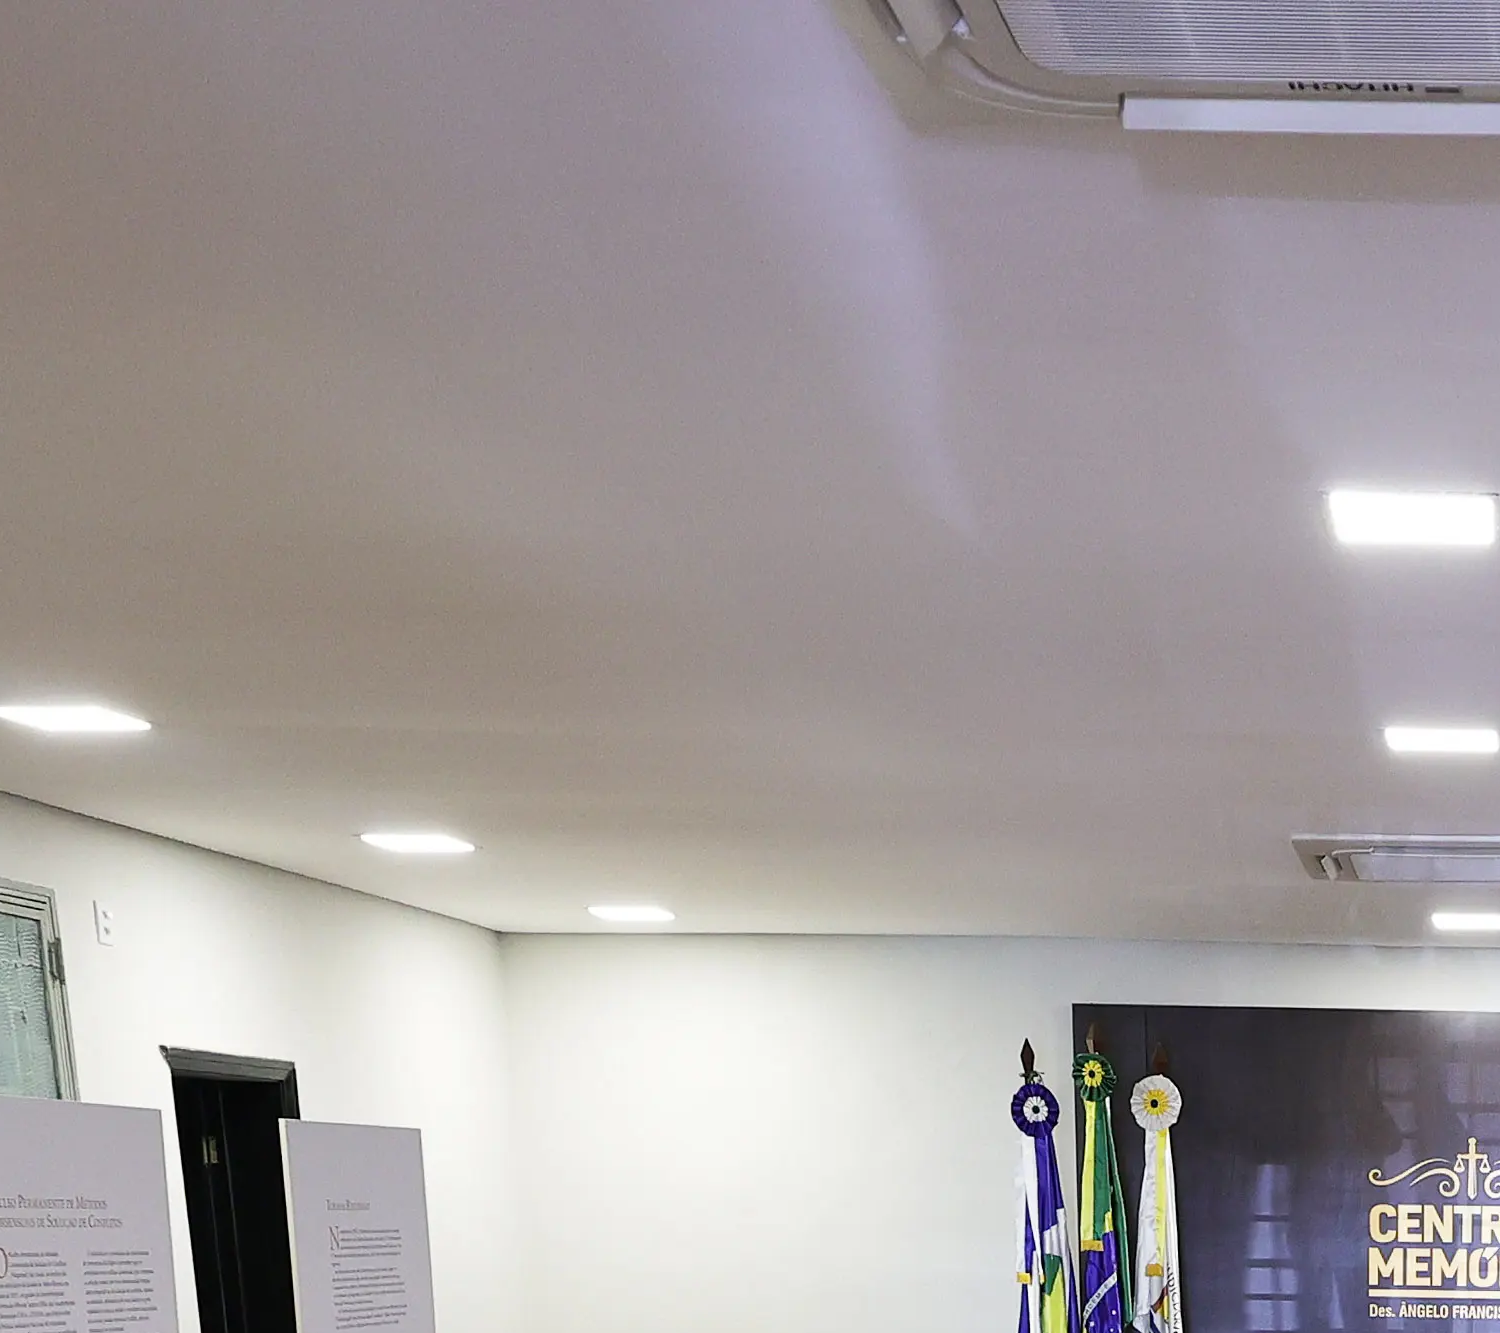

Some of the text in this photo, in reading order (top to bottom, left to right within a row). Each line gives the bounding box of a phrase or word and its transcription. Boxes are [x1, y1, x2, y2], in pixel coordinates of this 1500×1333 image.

[1288, 81, 1413, 92] HITACHI
[1369, 1304, 1395, 1318] Des.
[1399, 1301, 1449, 1319] ÂNGELO
